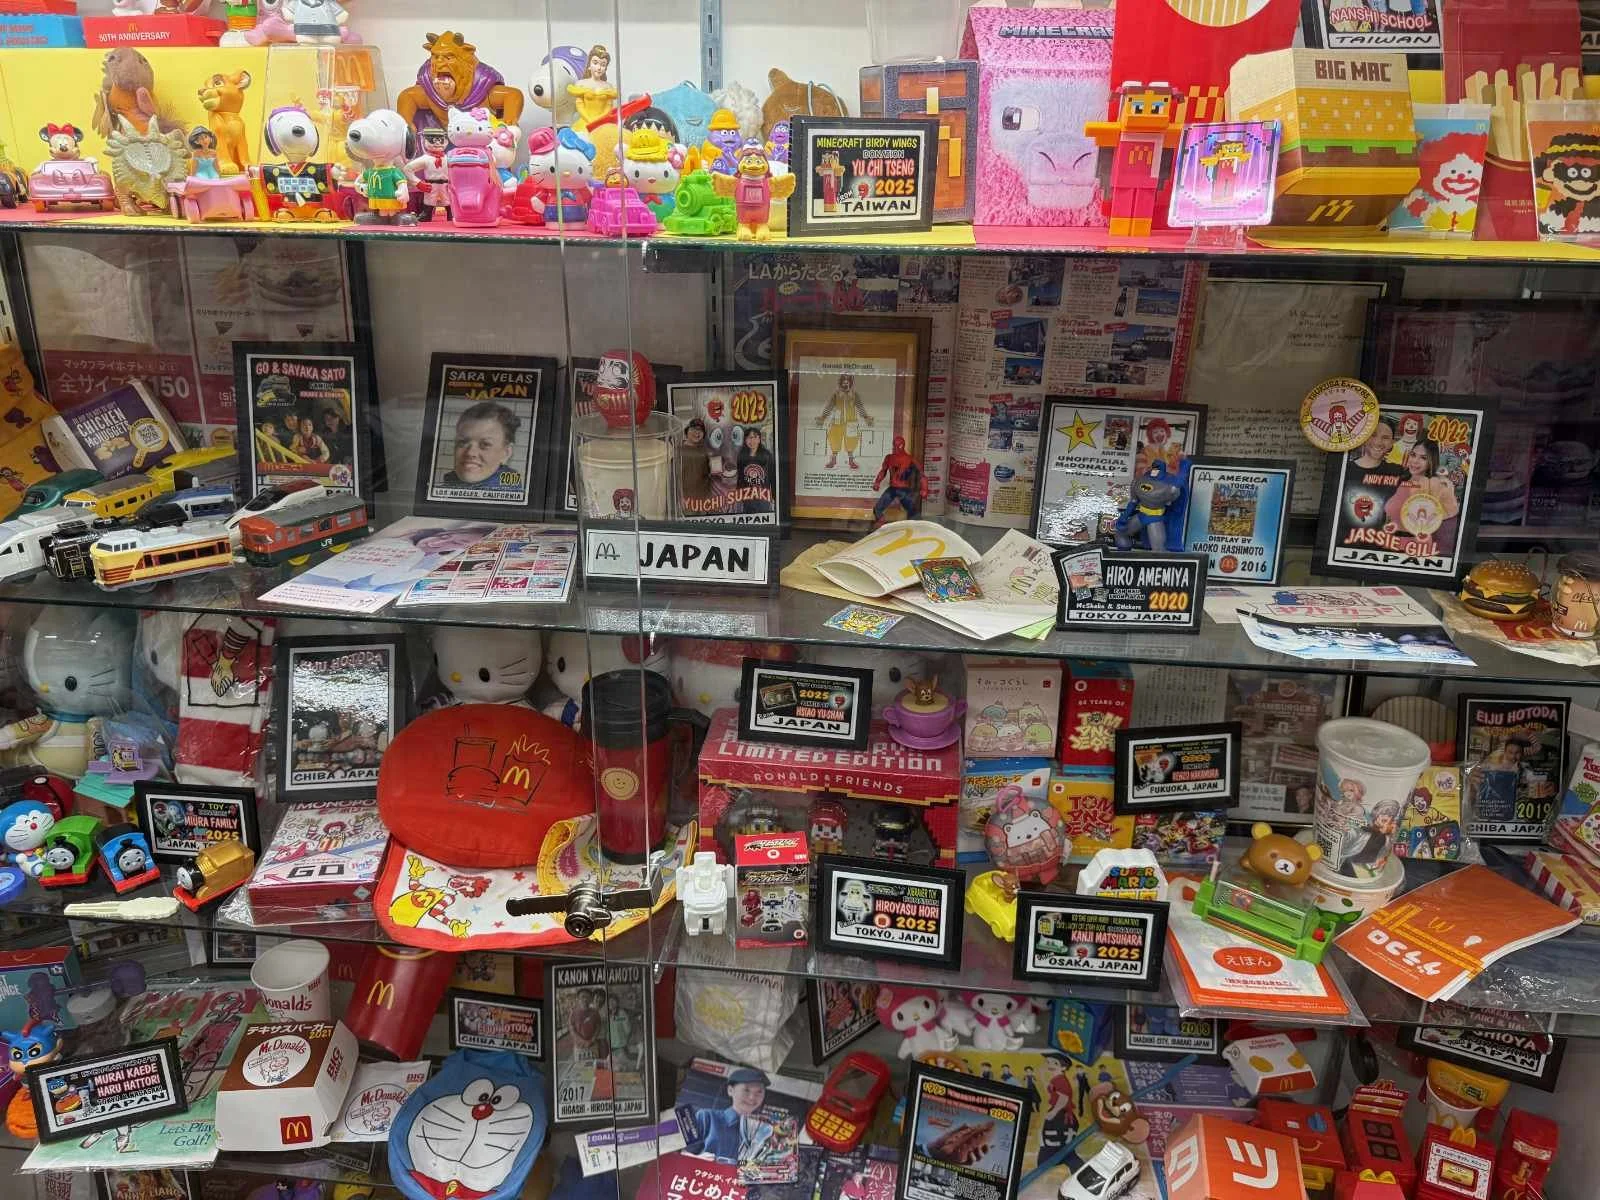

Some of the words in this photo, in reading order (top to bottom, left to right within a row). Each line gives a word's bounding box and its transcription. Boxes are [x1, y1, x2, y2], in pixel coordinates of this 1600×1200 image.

[1330, 8, 1379, 24] NANSHI
[1381, 14, 1432, 30] SCHOOL
[118, 31, 170, 41] ANNIVERSARY
[1335, 35, 1432, 45] TAIWAN
[1315, 60, 1346, 80] BIG
[1351, 61, 1391, 82] MAC
[816, 137, 862, 148] MINECRAFT
[865, 137, 889, 148] BIRDY
[892, 138, 918, 149] WINGS
[852, 160, 866, 176] YU
[867, 160, 883, 176] CHI
[885, 160, 915, 176] TSENG
[875, 178, 915, 196] 2025
[843, 199, 911, 212] TAIWAN
[255, 362, 269, 374] GO
[272, 362, 281, 374] &
[282, 362, 319, 380] SAYAKA
[320, 367, 346, 381] SATO
[449, 371, 486, 382] SARA
[491, 373, 534, 384] VELAS
[465, 384, 529, 400] JAPAN
[731, 391, 768, 423] 2023
[76, 407, 127, 437] CHICKEN
[1075, 428, 1084, 439] 6
[1427, 420, 1471, 445] 2022
[1055, 461, 1128, 473] McDONALD'S
[1057, 455, 1126, 466] UNOFFICIAL
[500, 472, 521, 485] 2017
[1218, 474, 1269, 483] AMERICA
[1363, 474, 1382, 485] ANDY
[1384, 475, 1400, 485] ROY
[482, 491, 521, 499] CALIFORNIA
[684, 497, 723, 513] YUICHI
[727, 488, 773, 505] SUZAKI
[731, 515, 770, 524] JAPAN
[320, 537, 333, 547] JR
[1208, 535, 1239, 544] DISPLAY
[1344, 527, 1402, 551] JASSIE
[1405, 541, 1440, 557] GILL
[1192, 543, 1219, 552] NAOKO
[1221, 544, 1264, 556] HASHIMOTO
[640, 542, 750, 573] JAPAN
[1343, 550, 1443, 568] JAPAN
[1241, 560, 1267, 572] 2016
[1106, 566, 1134, 586] HIRO
[1136, 566, 1189, 588] AMEMIYA
[1149, 591, 1189, 610] 2020
[1076, 611, 1127, 619] TOKYO
[1133, 613, 1181, 621] JAPAN
[800, 689, 830, 700] 2025
[1476, 710, 1504, 725] EIJU
[1507, 706, 1558, 722] HOTODA
[773, 718, 841, 731] JAPAN
[718, 743, 828, 763] LIMITED
[834, 752, 942, 772] EDITION
[294, 773, 335, 782] CHIBA
[754, 773, 819, 783] RONALD
[835, 775, 904, 794] FRIENDS
[1150, 783, 1190, 793] FUKUOKA,
[1192, 781, 1218, 790] JAPAN
[1517, 803, 1552, 818] 2019
[184, 815, 209, 827] MIURA
[210, 816, 238, 830] FAMILY
[1470, 823, 1506, 833] CHIBA
[206, 830, 239, 841] 2025
[167, 840, 199, 849] JAPAN,
[287, 864, 345, 879] GO
[1110, 866, 1154, 877] SUPER
[1099, 876, 1159, 889] MARIO
[875, 899, 917, 917] HIROYASU
[918, 904, 939, 918] HORI
[896, 916, 937, 932] 2025
[855, 927, 895, 940] TOKYO,
[899, 932, 934, 945] JAPAN
[1071, 930, 1094, 943] KANJI
[1096, 932, 1142, 946] MATSUHARA
[1097, 946, 1140, 959] 2025
[1049, 957, 1094, 969] OSAKA,
[1098, 961, 1138, 972] JAPAN
[1224, 955, 1272, 968] えほん
[558, 968, 589, 984] KANON
[247, 1023, 334, 1036] テキサスバーガー
[308, 1029, 332, 1040] 2021
[460, 1035, 496, 1045] CHIBA
[501, 1039, 536, 1051] JAPAN
[1461, 1038, 1536, 1068] JAPAN
[94, 1072, 125, 1086] MURAI
[127, 1063, 158, 1078] KAEDE
[97, 1084, 122, 1097] HARU
[125, 1075, 161, 1091] HATTORI
[562, 1087, 585, 1102] 2017
[96, 1092, 165, 1113] JAPAN
[561, 1105, 586, 1116] HIGASHI
[624, 1102, 642, 1112] JAPAN
[159, 1124, 186, 1136] Let's
[188, 1122, 214, 1135] Play
[173, 1134, 212, 1147] Golf!
[1168, 1134, 1198, 1192] タ
